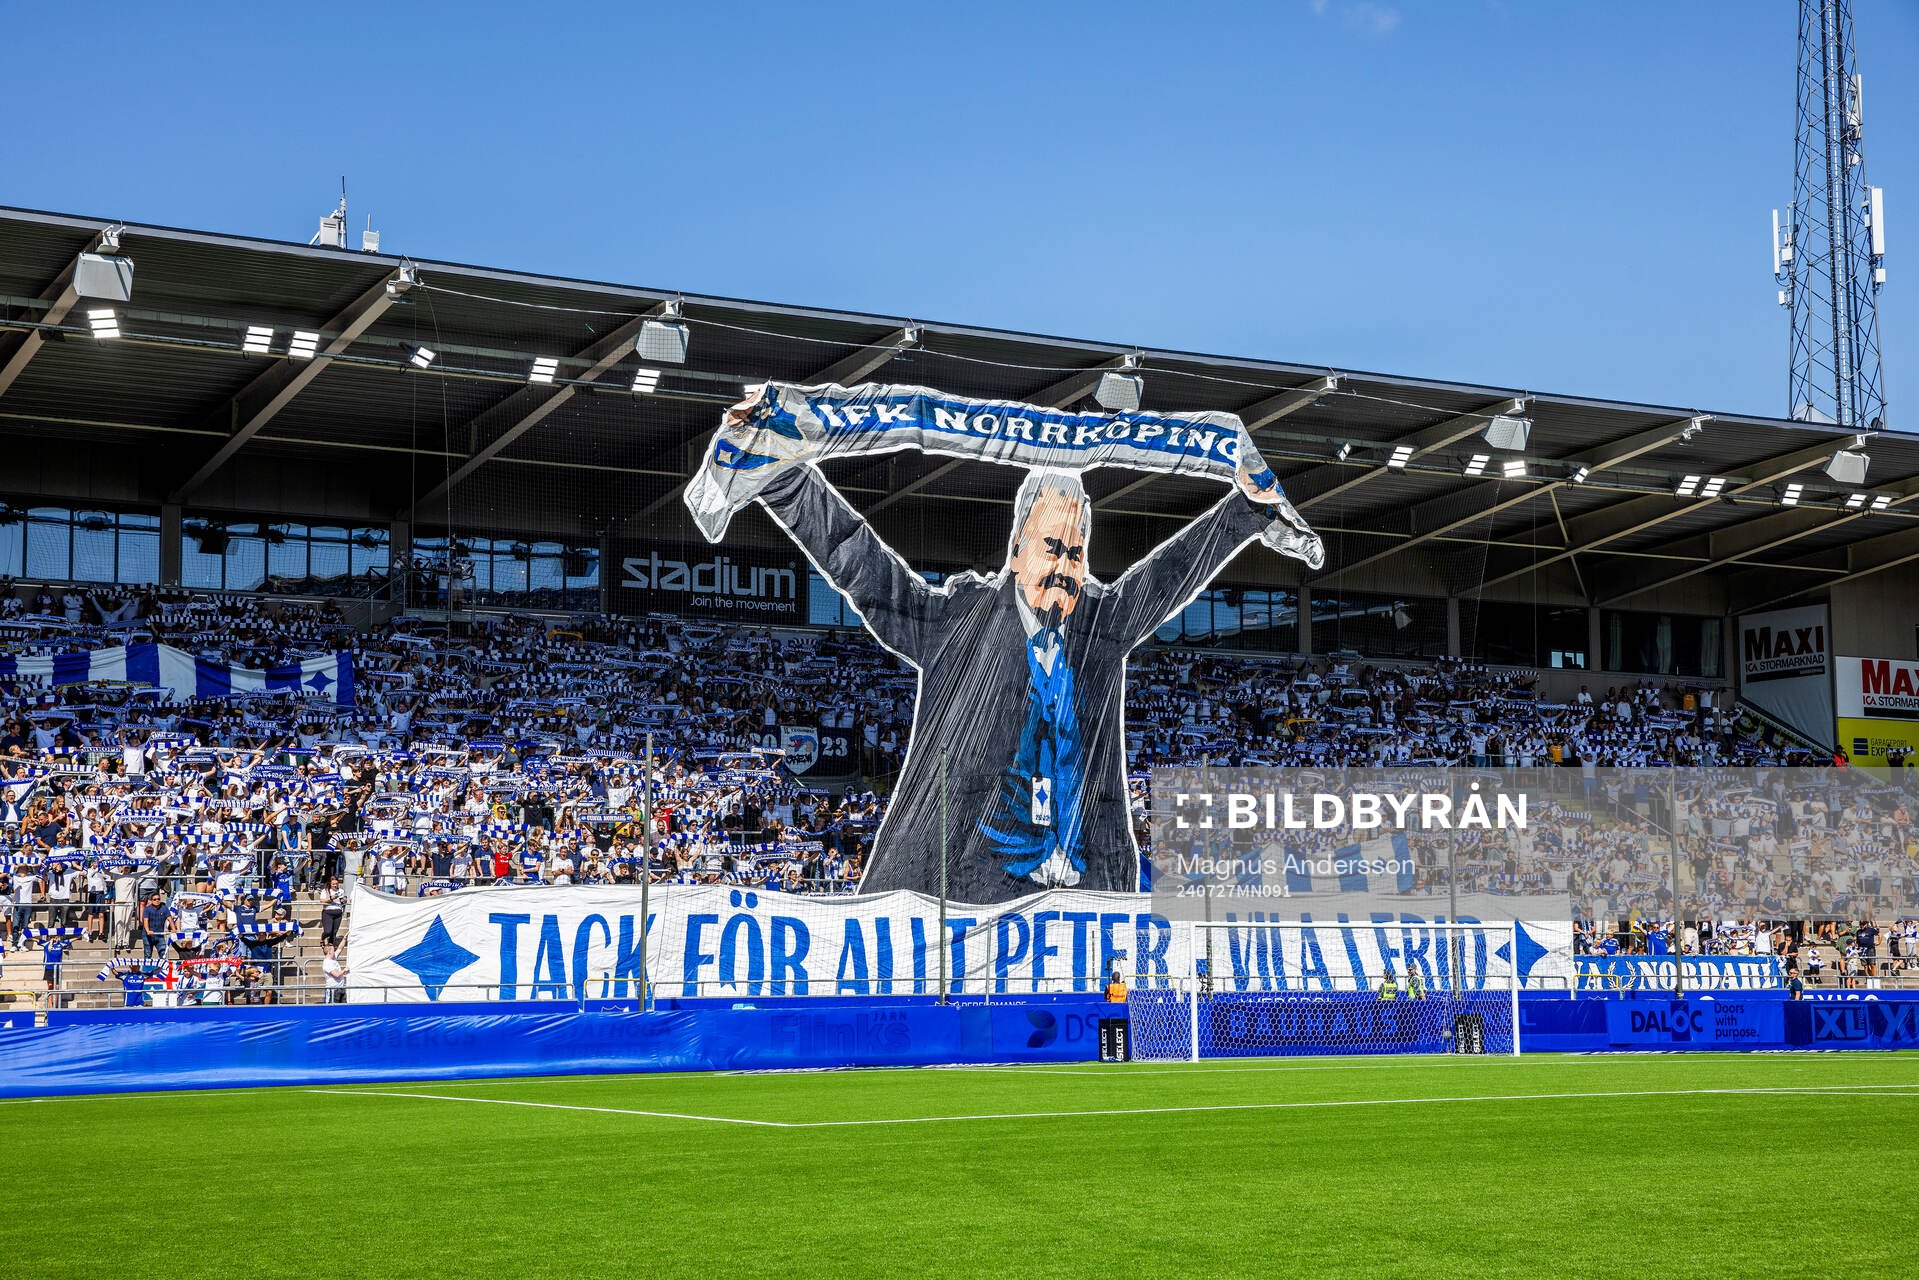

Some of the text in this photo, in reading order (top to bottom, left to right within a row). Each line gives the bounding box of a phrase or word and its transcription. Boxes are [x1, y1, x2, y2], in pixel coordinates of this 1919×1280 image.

[816, 402, 1240, 462] IFK NORRKÖPING
[622, 551, 796, 599] stadium
[690, 596, 796, 613] Join the movement
[1744, 625, 1825, 662] MAXI
[1746, 662, 1759, 673] ICA
[1760, 654, 1825, 672] STORMARKNAD
[1861, 659, 1919, 697] MA
[1863, 695, 1877, 706] ICA
[821, 736, 848, 757] 23
[488, 912, 657, 1000] TACK
[683, 890, 811, 997] FÖR
[1636, 960, 1779, 990] NORDAHL
[1630, 1008, 1703, 1034] DALOC
[1714, 1002, 1745, 1014] Doors
[1714, 1015, 1738, 1026] with
[1878, 1003, 1919, 1042] X
[1230, 1009, 1398, 1038] BAUHAUS
[1714, 1028, 1760, 1040] purpose.
[1816, 1009, 1866, 1038] XL
[1115, 1027, 1124, 1061] SELECT
